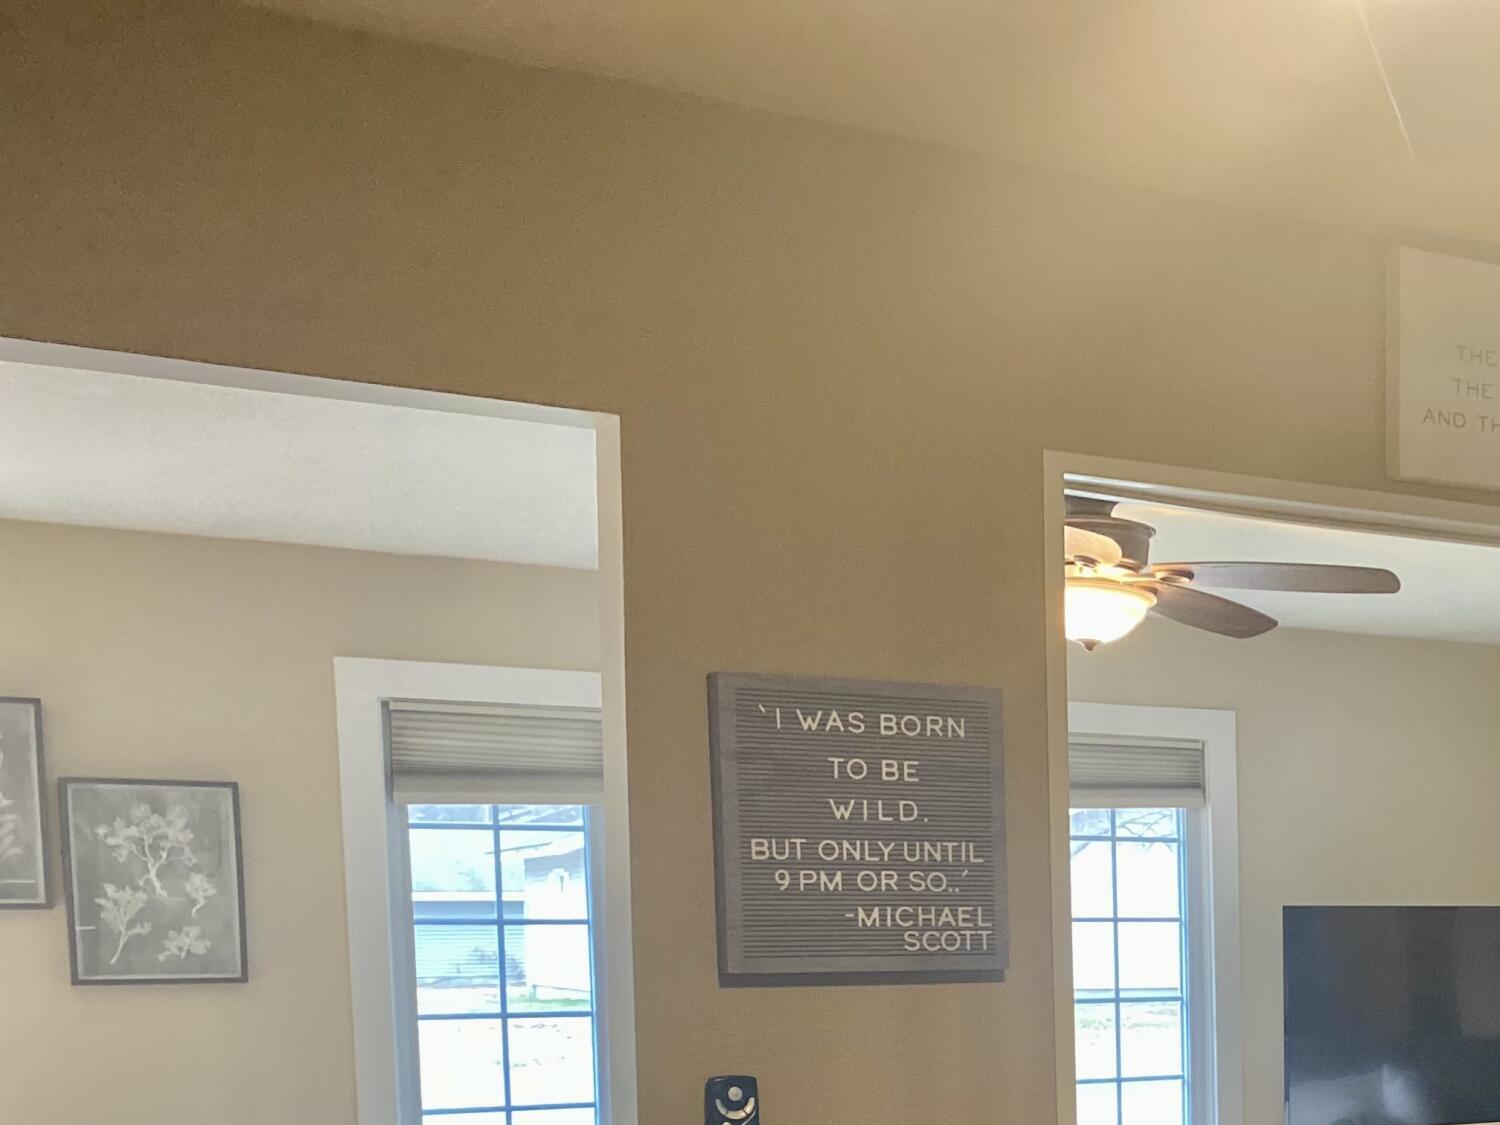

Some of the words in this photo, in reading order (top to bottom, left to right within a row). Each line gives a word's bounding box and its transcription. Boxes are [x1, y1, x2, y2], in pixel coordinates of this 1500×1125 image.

[1457, 345, 1497, 367] THE
[1452, 378, 1494, 400] THE
[1422, 408, 1466, 428] AND
[796, 709, 865, 733] WAS
[880, 713, 966, 738] BORN
[828, 757, 867, 780] TO
[881, 760, 920, 782] BE
[829, 799, 929, 822] WILD.
[751, 838, 807, 860] BUT
[818, 840, 895, 862] ONLY
[903, 842, 984, 863] UNTIL
[857, 871, 898, 891] OR
[904, 930, 993, 952] SCOTT
